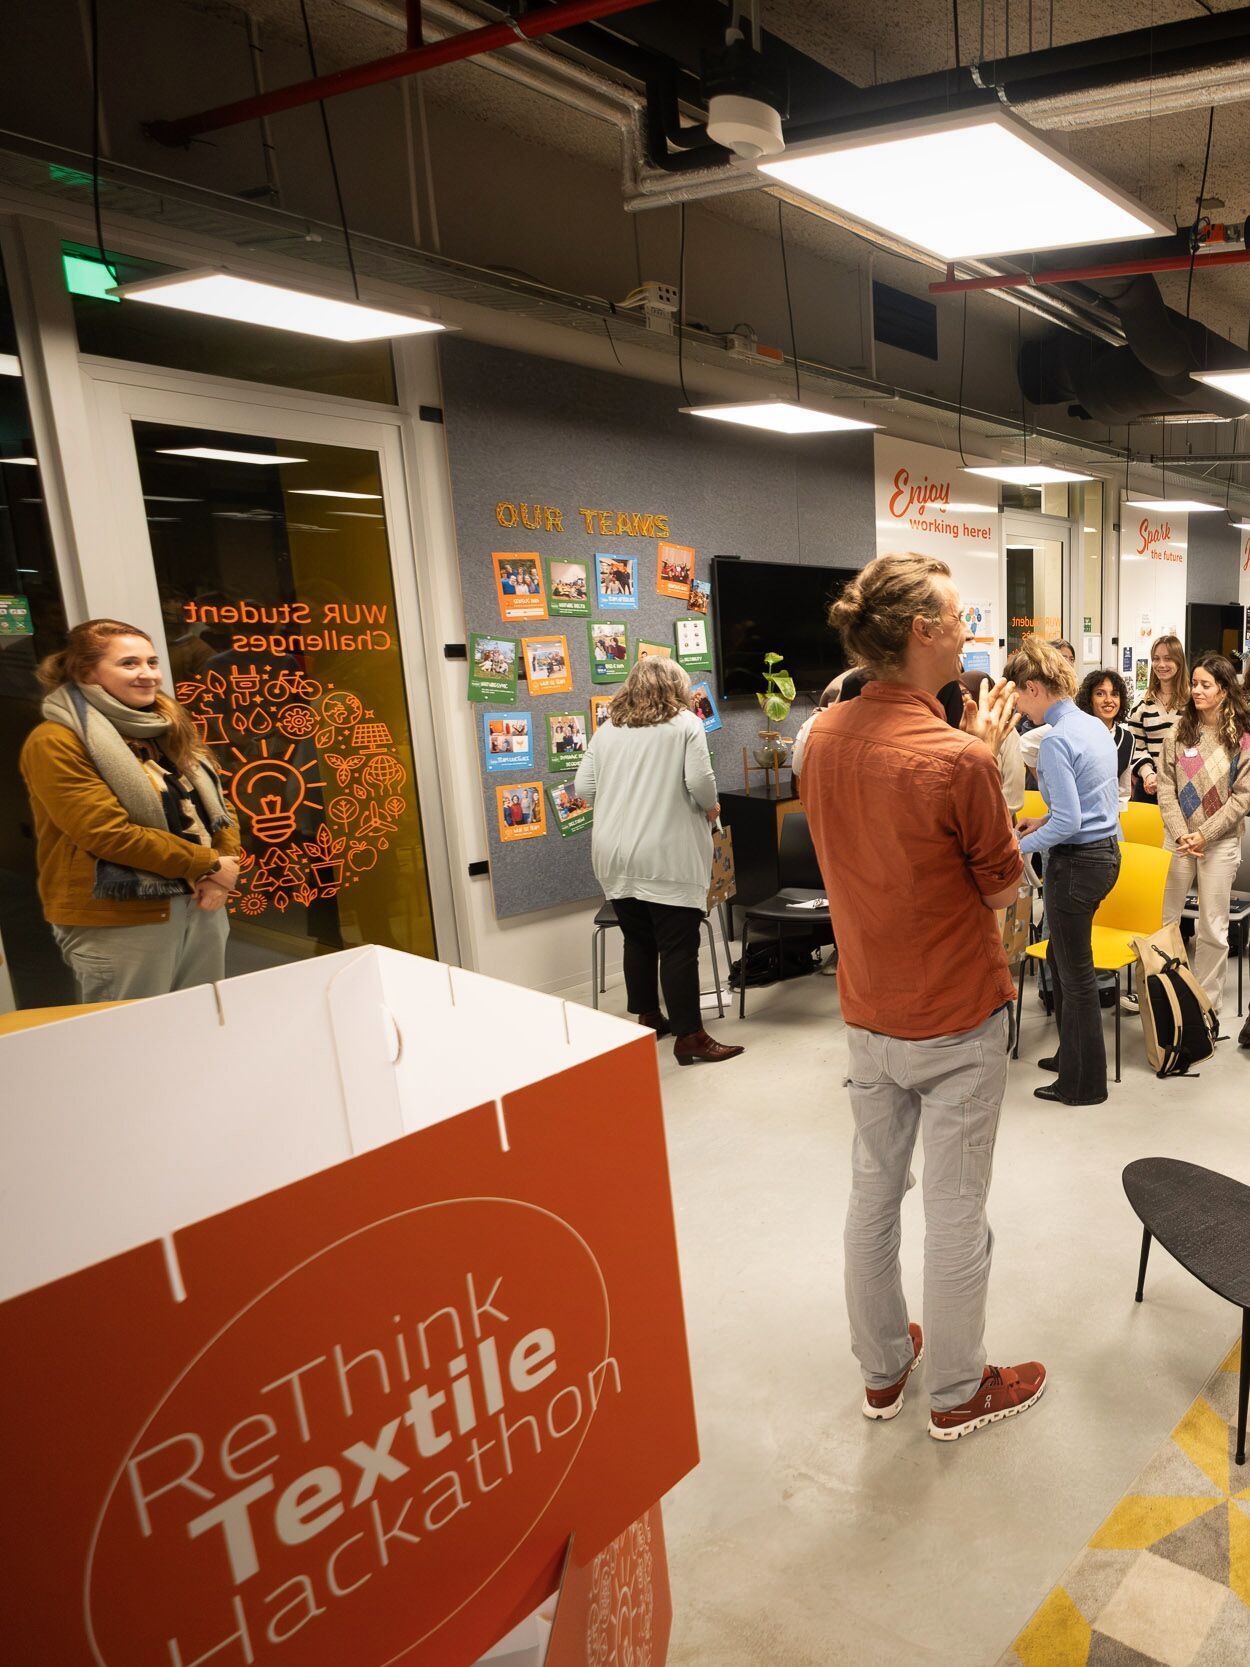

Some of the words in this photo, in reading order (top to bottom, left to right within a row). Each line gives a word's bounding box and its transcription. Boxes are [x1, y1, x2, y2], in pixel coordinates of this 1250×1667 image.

[889, 467, 951, 519] Enjoy
[495, 501, 565, 533] OUR
[579, 508, 671, 539] TEAMS
[909, 518, 959, 539] working
[962, 522, 992, 540] here!
[1136, 518, 1171, 555] Spark
[1151, 549, 1162, 560] the
[1163, 550, 1183, 563] future
[126, 1271, 510, 1537] ReThink
[187, 1326, 558, 1586] Textile
[167, 1356, 623, 1667] Hackathon
